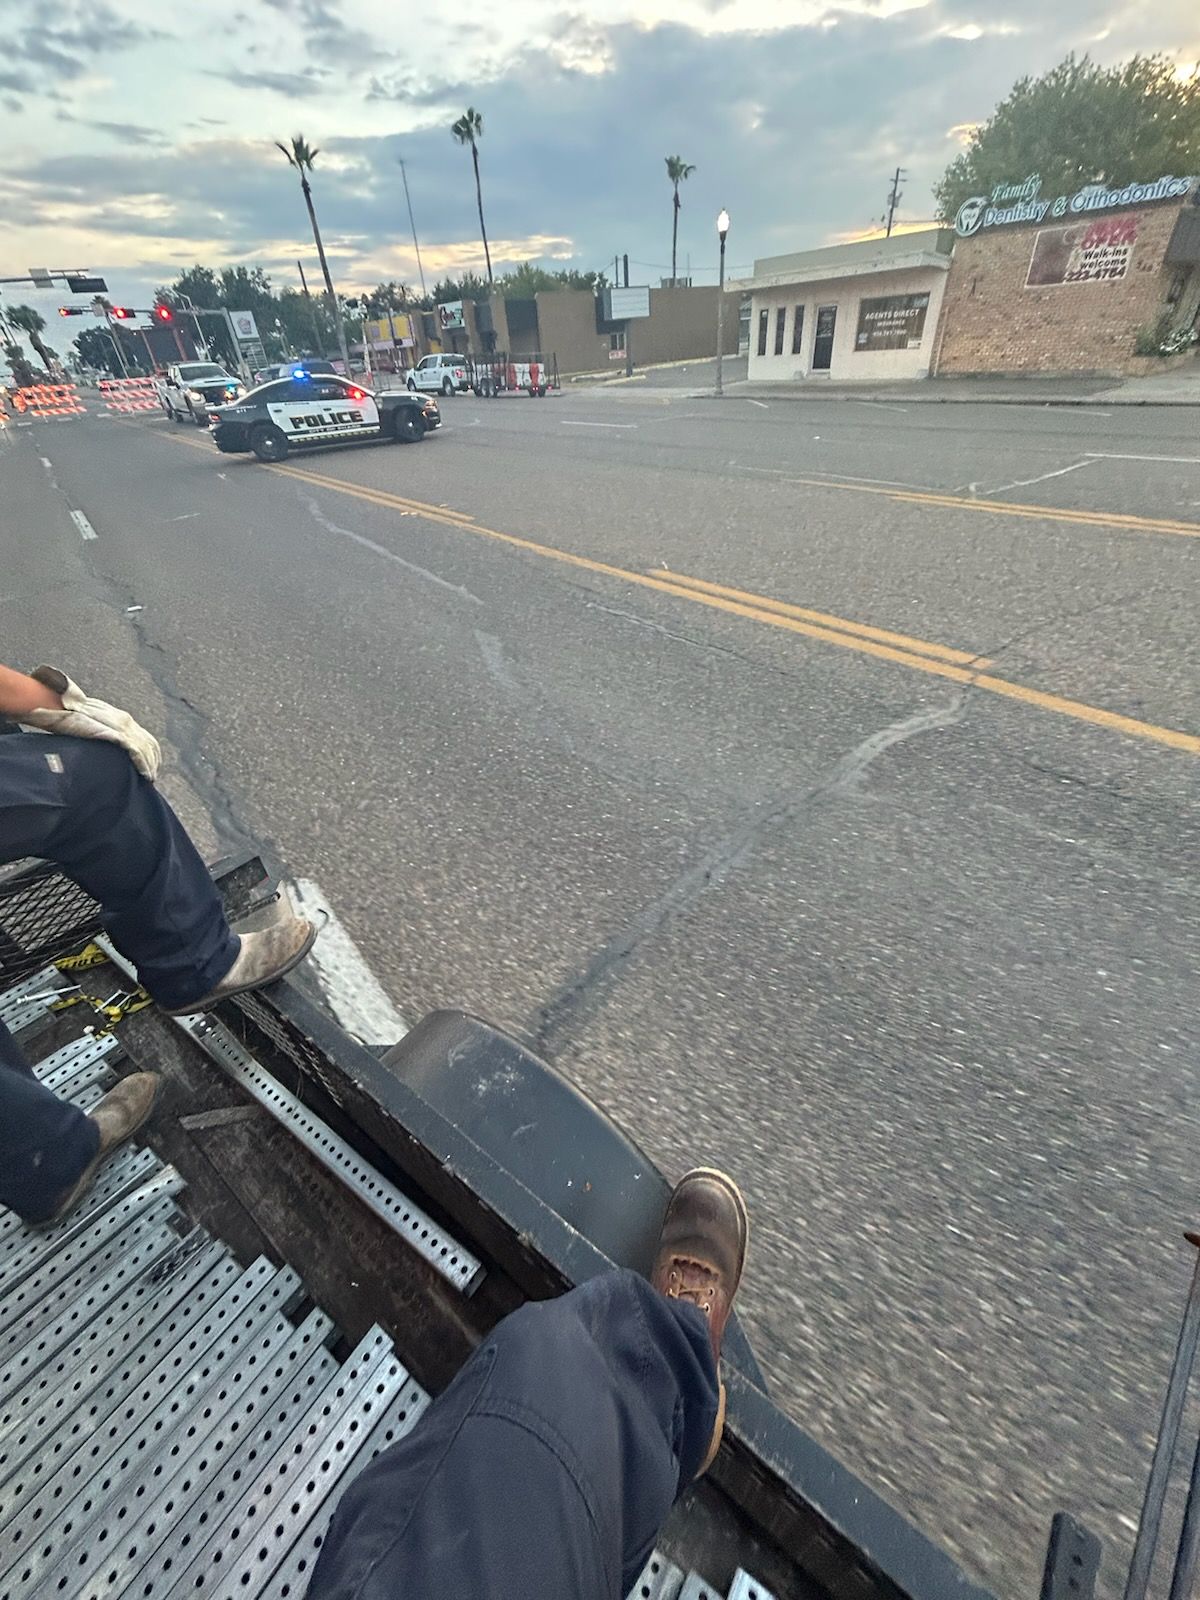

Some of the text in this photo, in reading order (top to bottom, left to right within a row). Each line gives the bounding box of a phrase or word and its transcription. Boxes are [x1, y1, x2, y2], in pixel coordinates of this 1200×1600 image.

[991, 173, 1042, 202] Family
[983, 175, 1192, 227] Dentistry & Orthodontics
[1080, 258, 1127, 270] welcome
[865, 308, 919, 320] AGENTS DIRECT
[289, 410, 364, 429] POLICE
